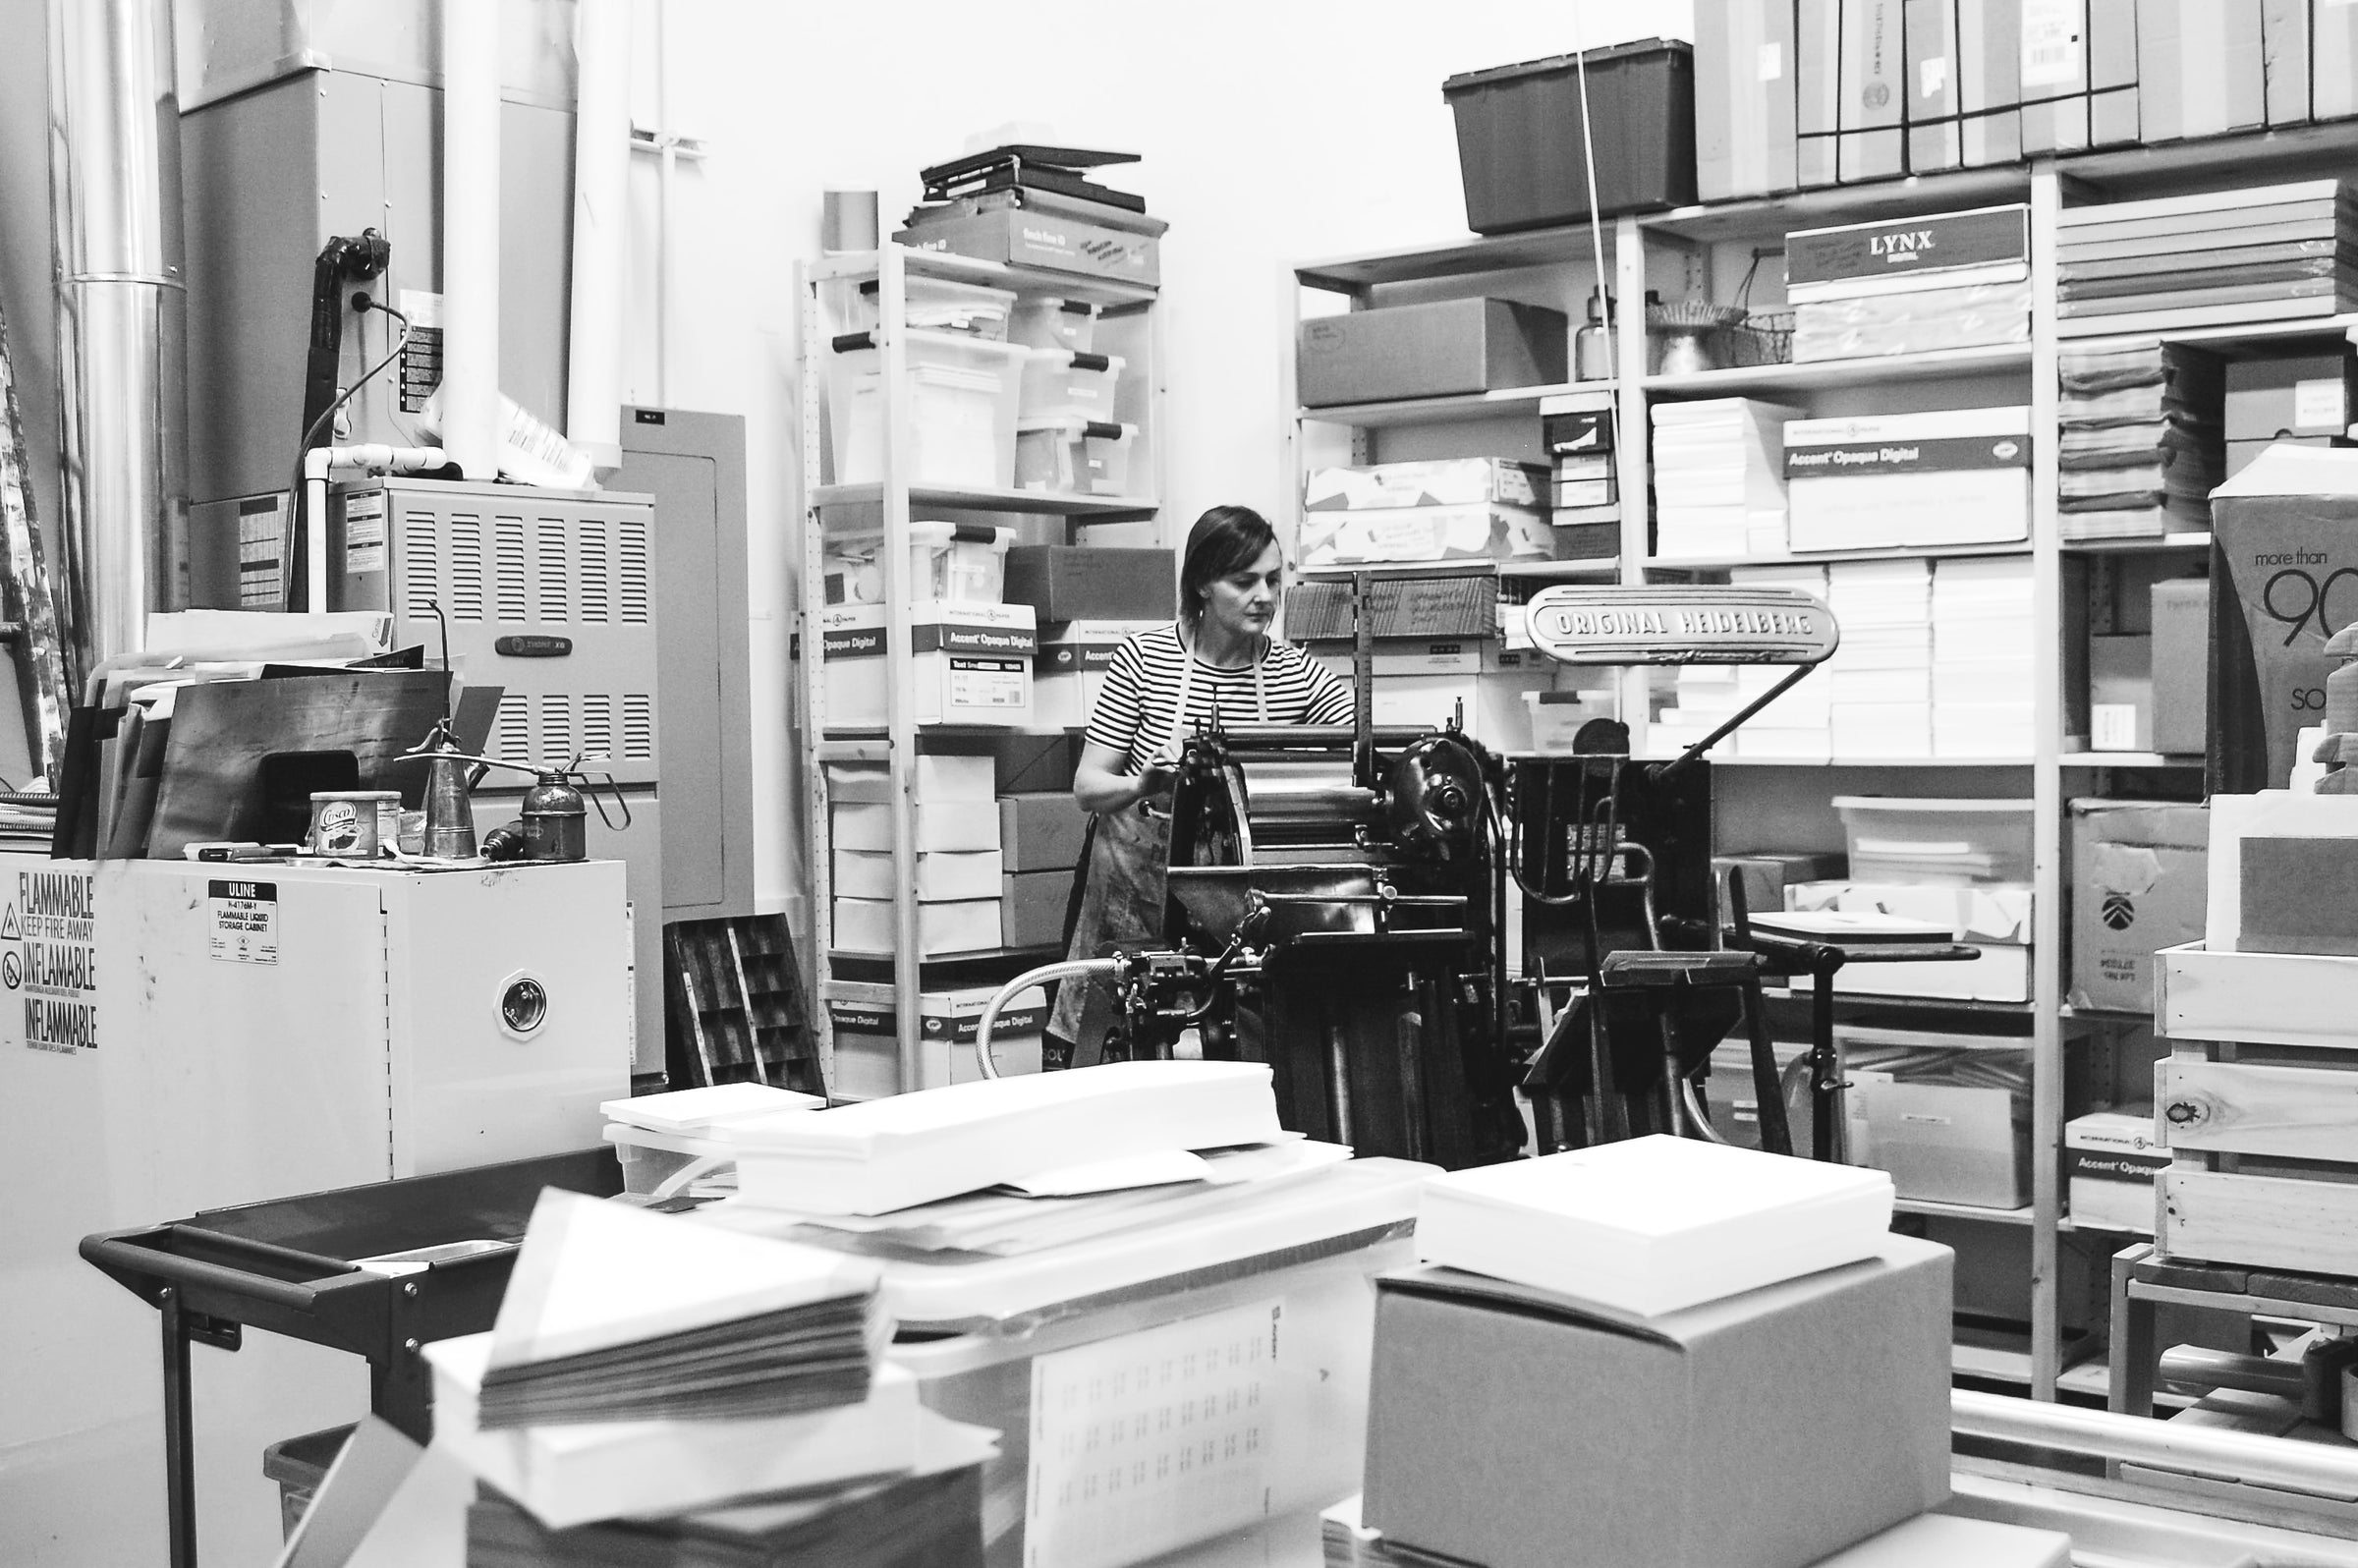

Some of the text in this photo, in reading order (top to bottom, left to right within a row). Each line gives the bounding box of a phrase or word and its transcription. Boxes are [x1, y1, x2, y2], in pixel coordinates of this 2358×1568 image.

[1870, 230, 1934, 255] LYNX
[1832, 450, 1879, 466] Opaque
[1880, 447, 1919, 464] Digital
[2255, 546, 2328, 567] more than
[1555, 611, 1814, 636] ORIGINAL HEIDELBERG
[852, 637, 876, 649] Digital
[981, 633, 1010, 647] Opaque
[1010, 635, 1034, 648] Digital
[324, 809, 350, 827] Crisco
[20, 871, 94, 920] FLAMMABLE
[229, 882, 255, 898] ULINE
[218, 910, 268, 923] FLAMMABLE LIQUID
[22, 915, 94, 943] KEEP FIRE AWAY
[219, 921, 267, 932] STORAGE CABINET
[24, 941, 96, 991] INFLAMABLE
[25, 997, 98, 1049] INFLAMMABLE
[857, 1015, 879, 1026] Digital
[958, 1023, 981, 1033] Accen
[1011, 1015, 1034, 1027] Digital
